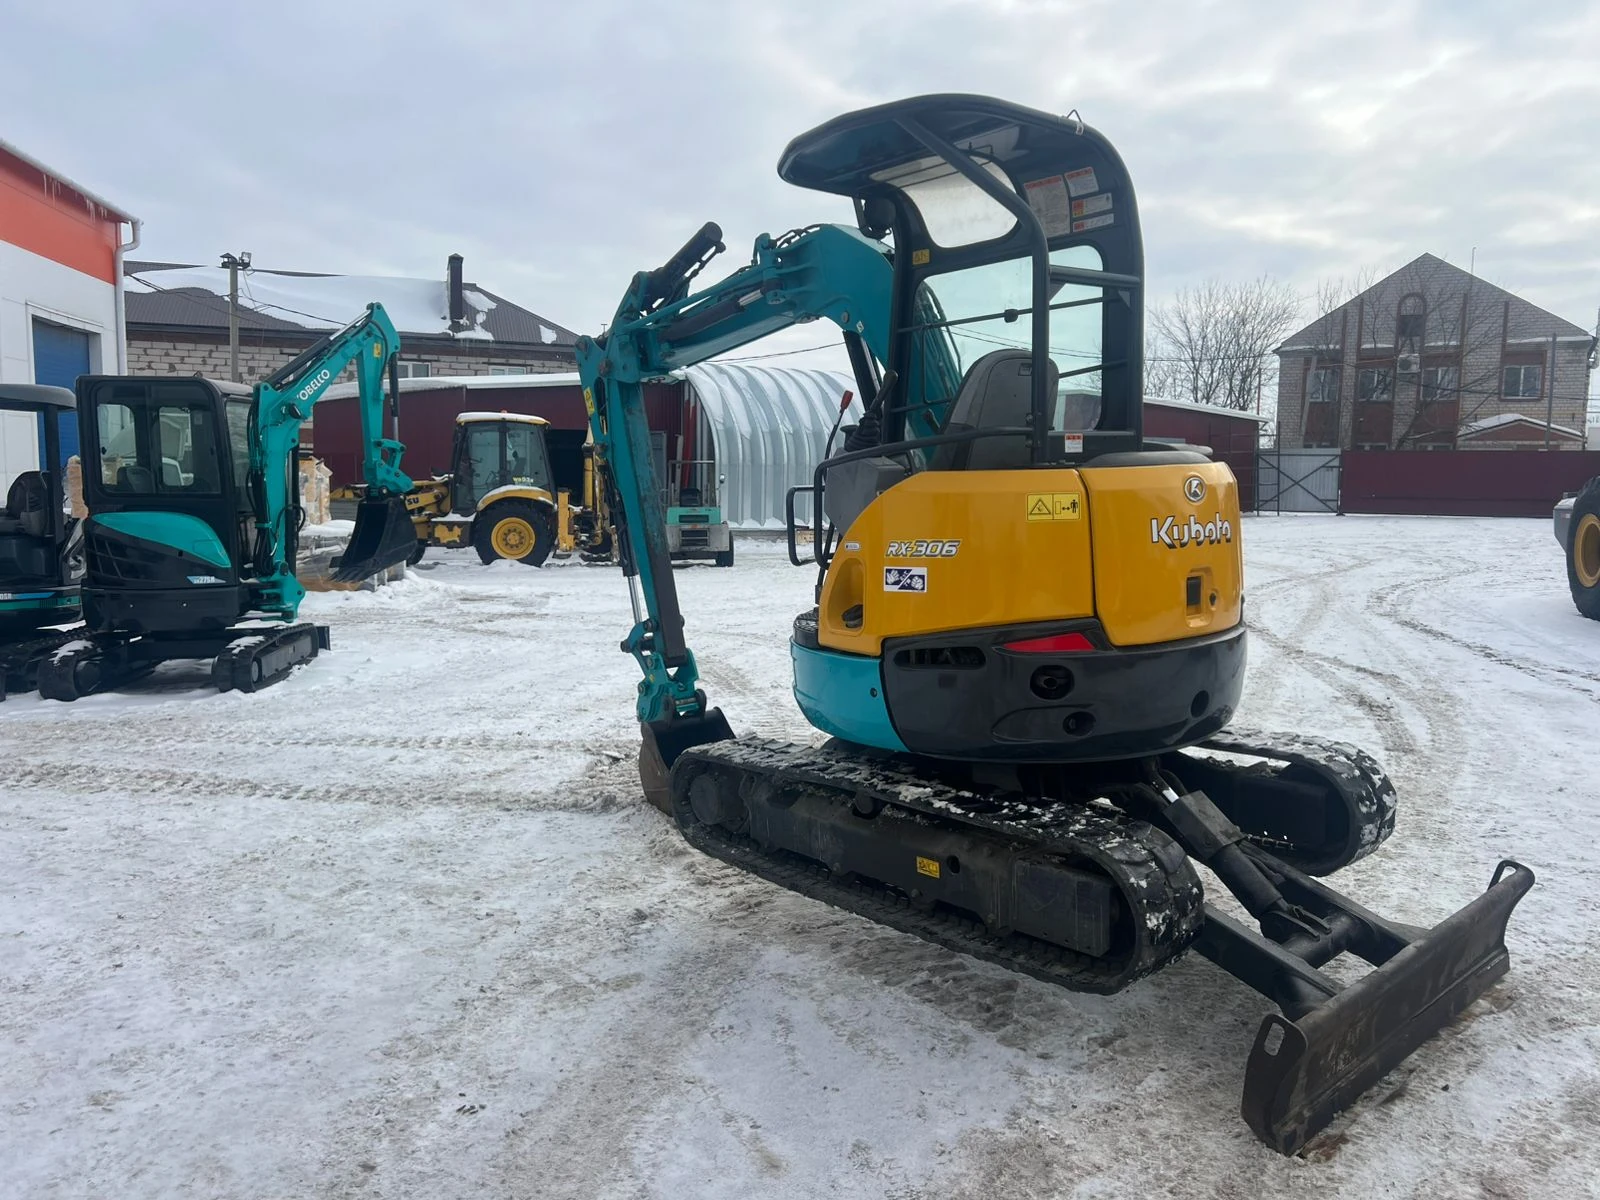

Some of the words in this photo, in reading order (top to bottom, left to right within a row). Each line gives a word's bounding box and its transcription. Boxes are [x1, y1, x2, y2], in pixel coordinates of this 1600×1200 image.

[297, 369, 330, 400] OBELCO
[1150, 512, 1232, 549] Kubota
[886, 540, 961, 558] RX-306
